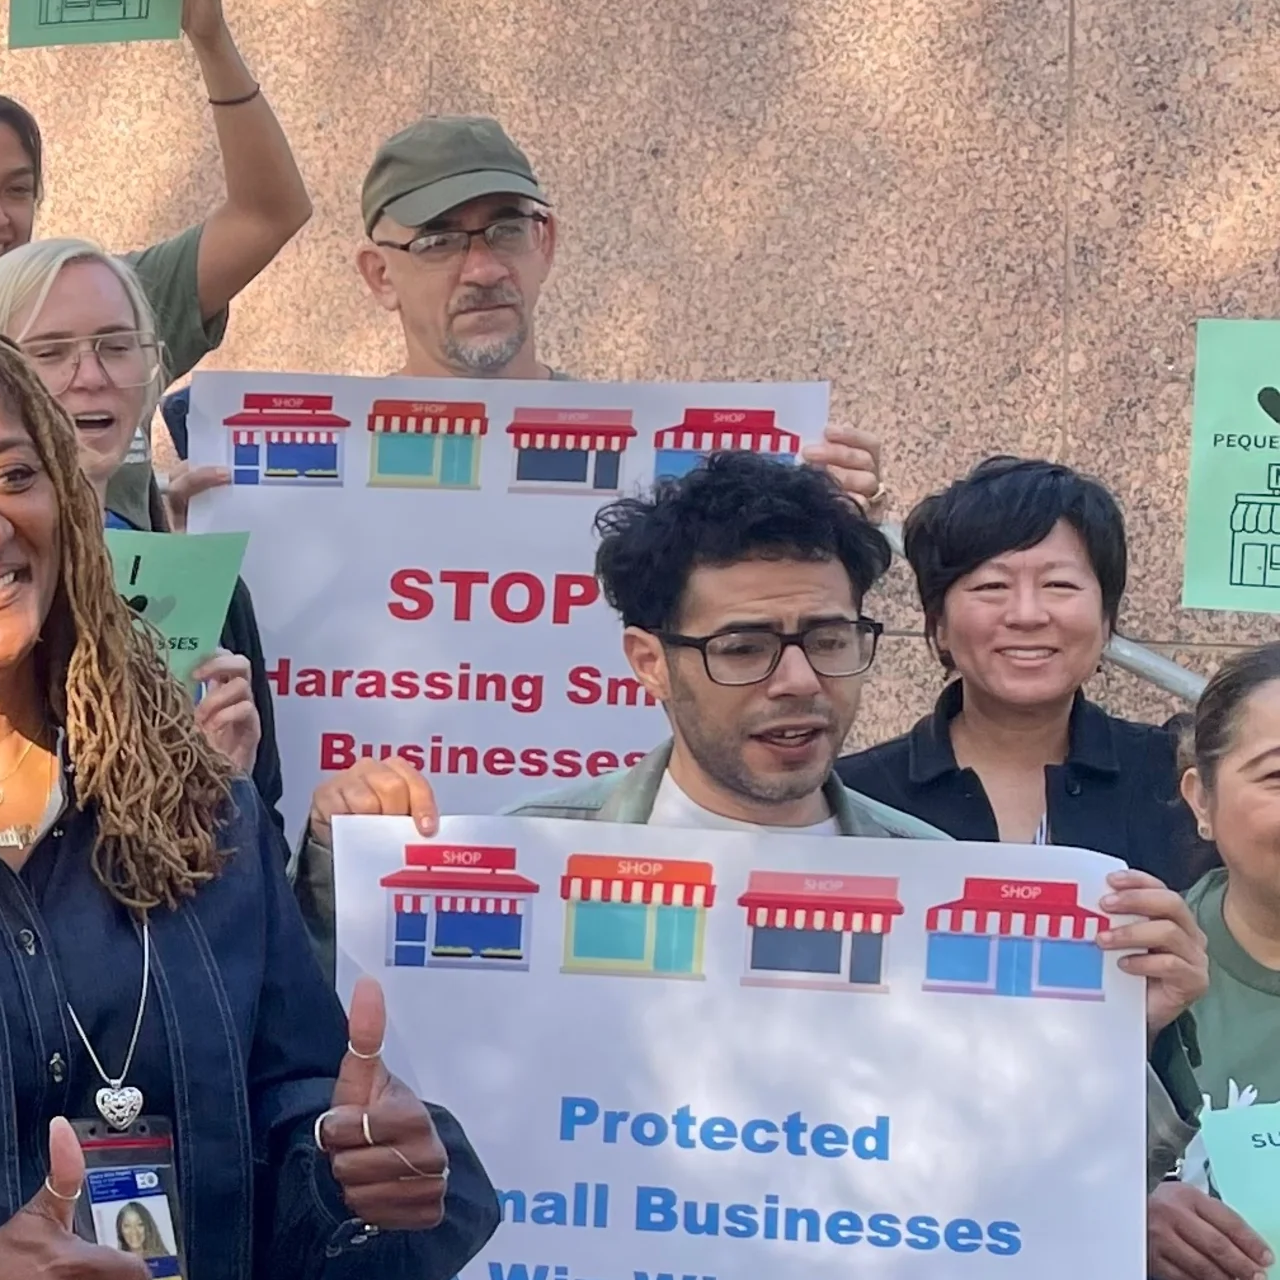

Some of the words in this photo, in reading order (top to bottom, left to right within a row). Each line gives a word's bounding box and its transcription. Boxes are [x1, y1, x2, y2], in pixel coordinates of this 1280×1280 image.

[271, 396, 304, 409] SHOP
[411, 402, 447, 415] SHOP
[712, 411, 746, 425] SHOP
[129, 554, 142, 586] I
[387, 568, 599, 625] STOP
[265, 657, 544, 713] Harassing
[441, 848, 482, 866] SHOP
[616, 859, 663, 877] SHOP
[803, 877, 844, 892] SHOP
[999, 882, 1042, 900] SHOP
[558, 1095, 891, 1161] Protected
[493, 1181, 609, 1229] mall
[634, 1184, 1022, 1257] Businesses
